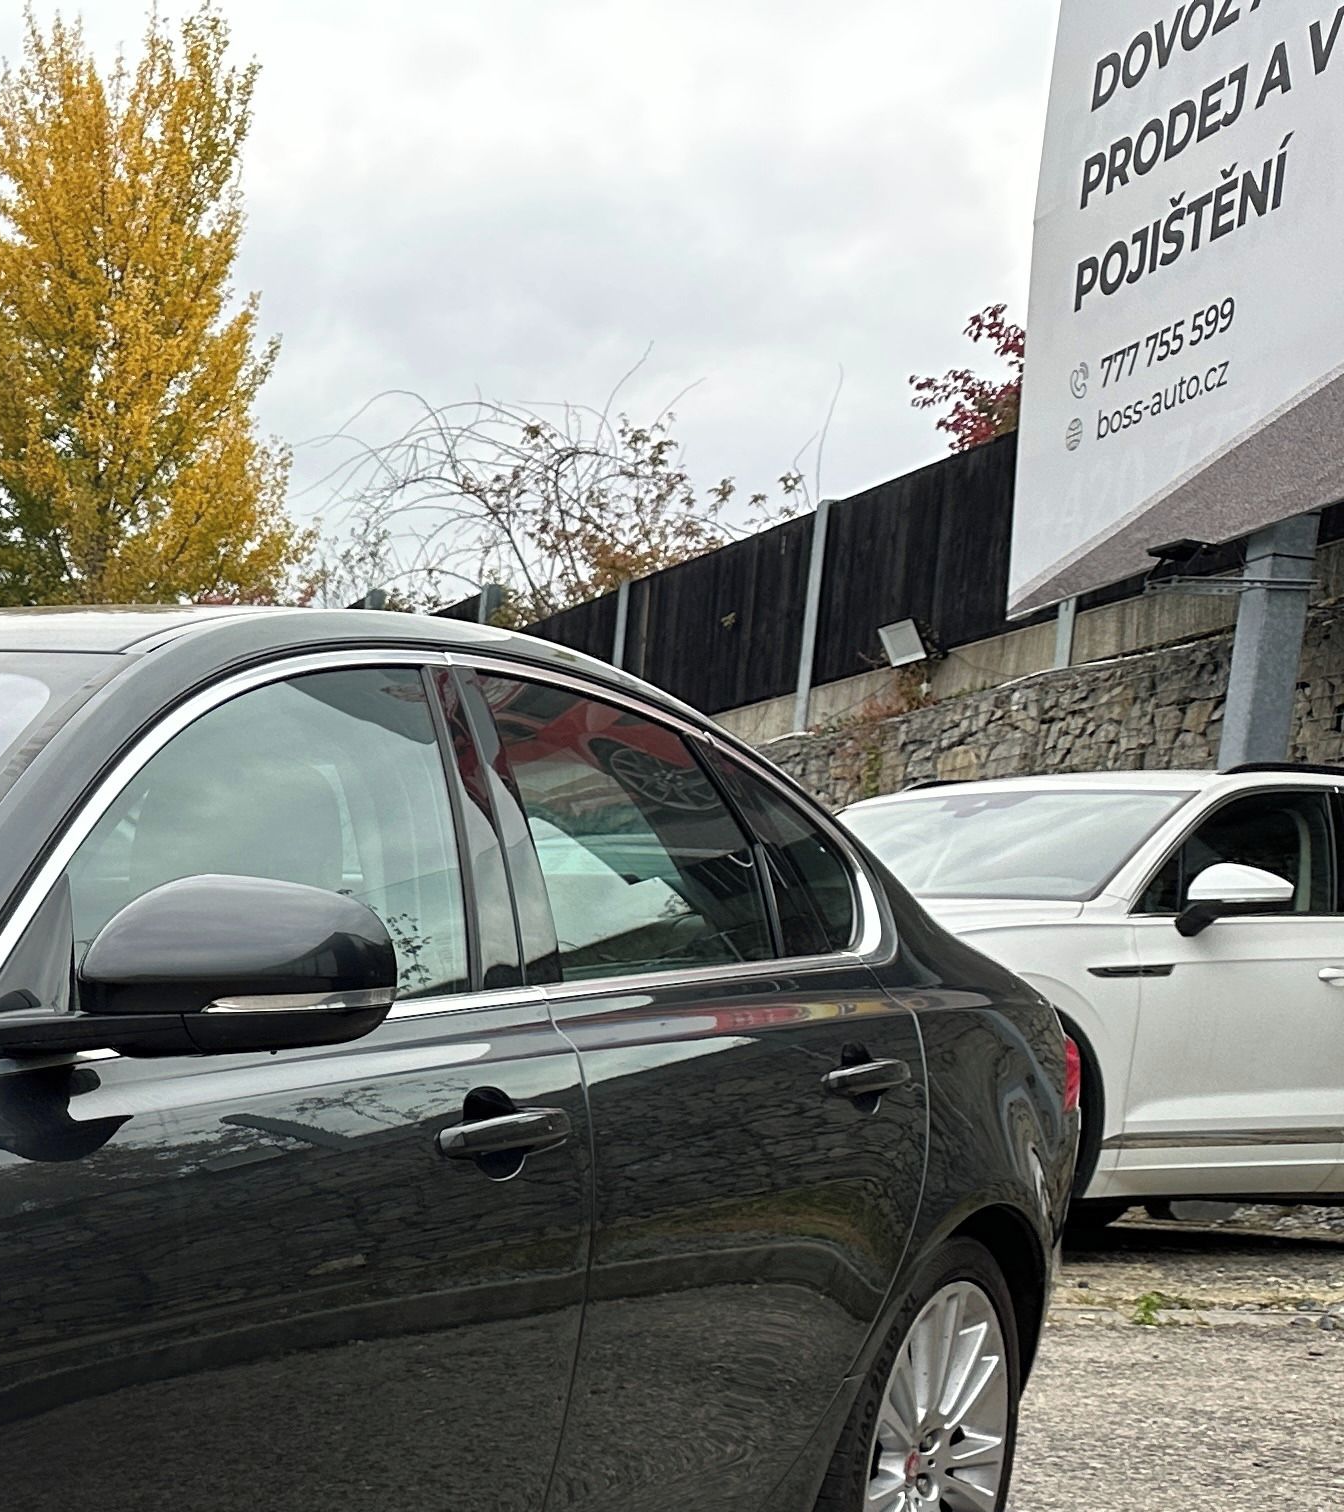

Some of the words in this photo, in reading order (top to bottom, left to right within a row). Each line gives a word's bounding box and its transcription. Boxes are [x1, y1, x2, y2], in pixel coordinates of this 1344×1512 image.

[1080, 63, 1249, 209] PRODEJ
[1255, 41, 1291, 110] A
[1074, 131, 1295, 311] POJIŠTĚNÍ
[1096, 361, 1230, 440] boss-auto.cz
[1101, 341, 1140, 388] 777
[1145, 320, 1185, 367] 755
[1189, 297, 1235, 346] 599
